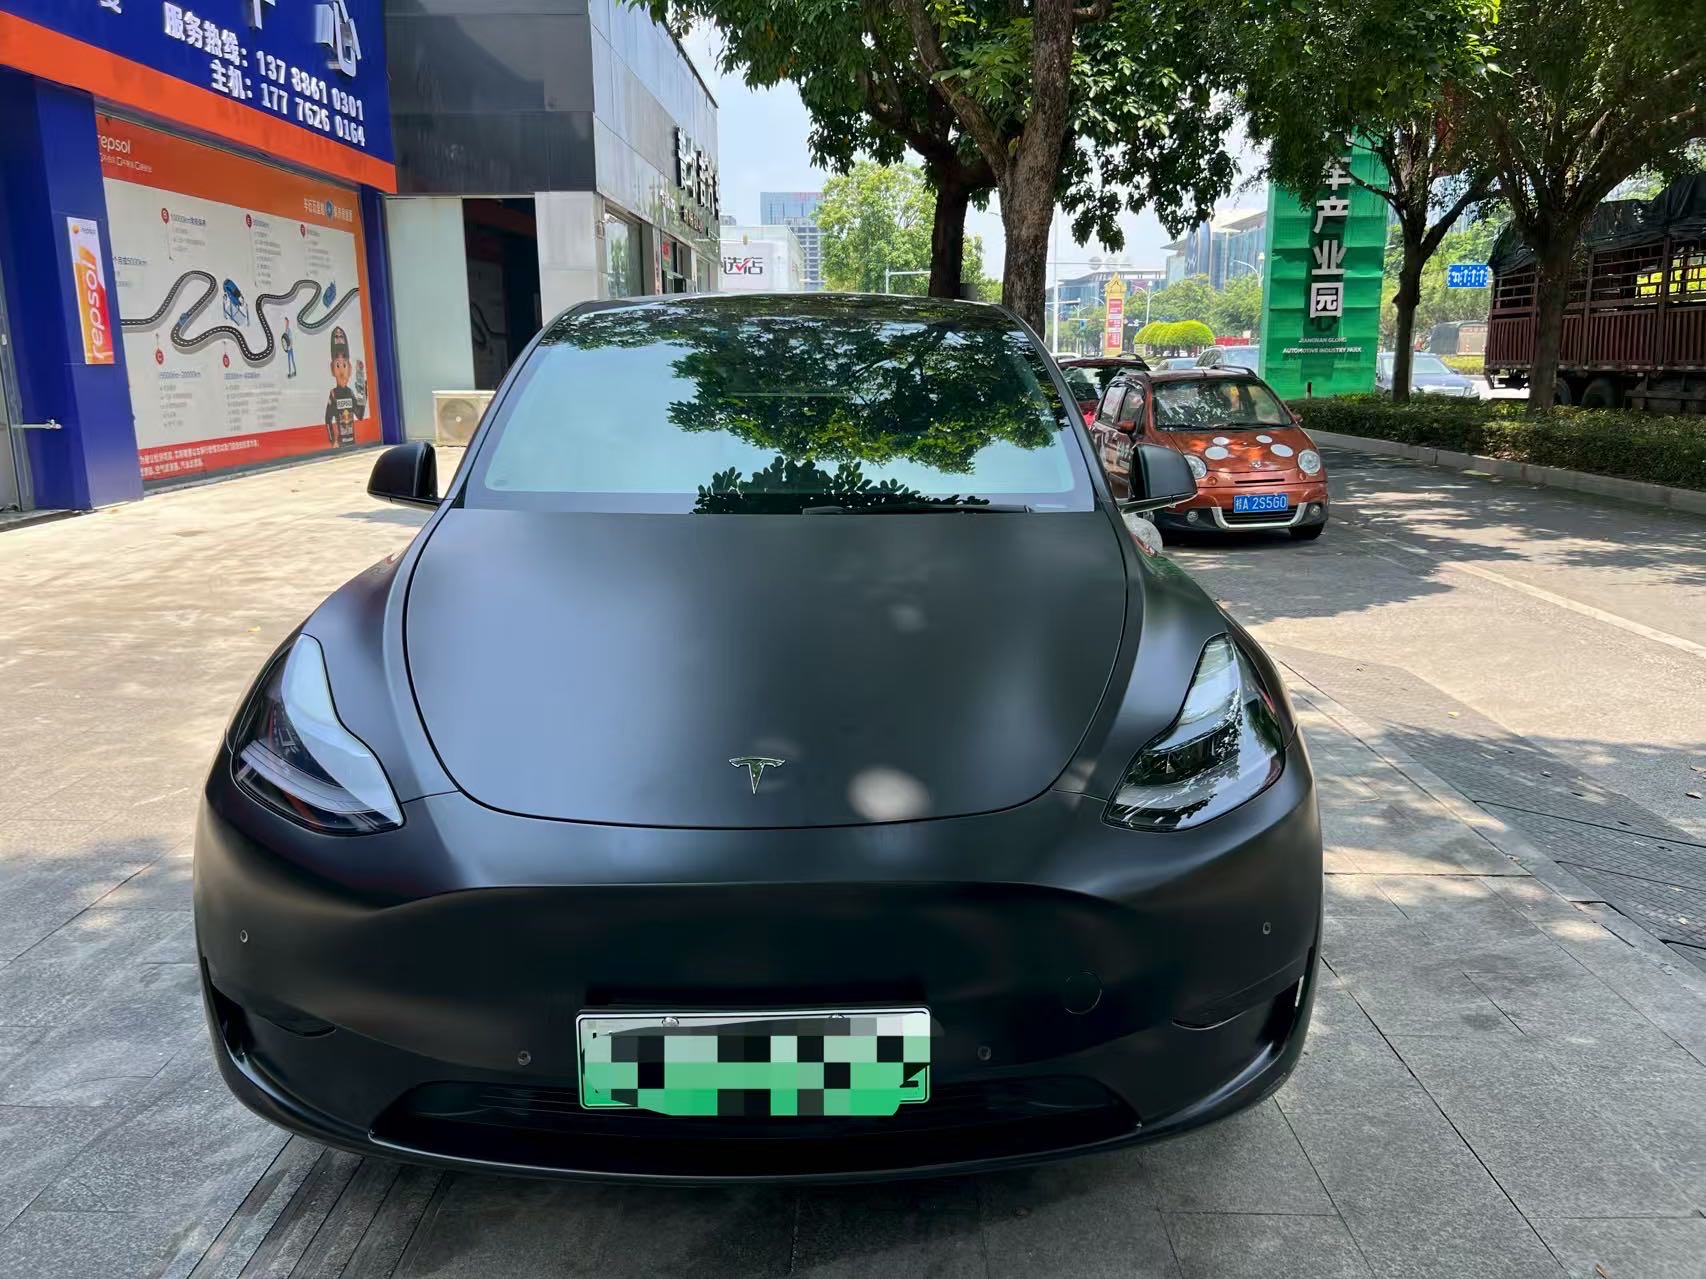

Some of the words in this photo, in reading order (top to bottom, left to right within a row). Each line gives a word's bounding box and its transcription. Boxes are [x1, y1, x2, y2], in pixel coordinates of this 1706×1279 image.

[256, 50, 287, 85] 137
[290, 67, 328, 105] 8861
[331, 87, 364, 121] 0301
[260, 82, 289, 115] 177
[294, 97, 331, 132] 7626
[334, 115, 366, 147] 0164
[720, 256, 764, 276] 选店
[80, 256, 106, 360] repsol
